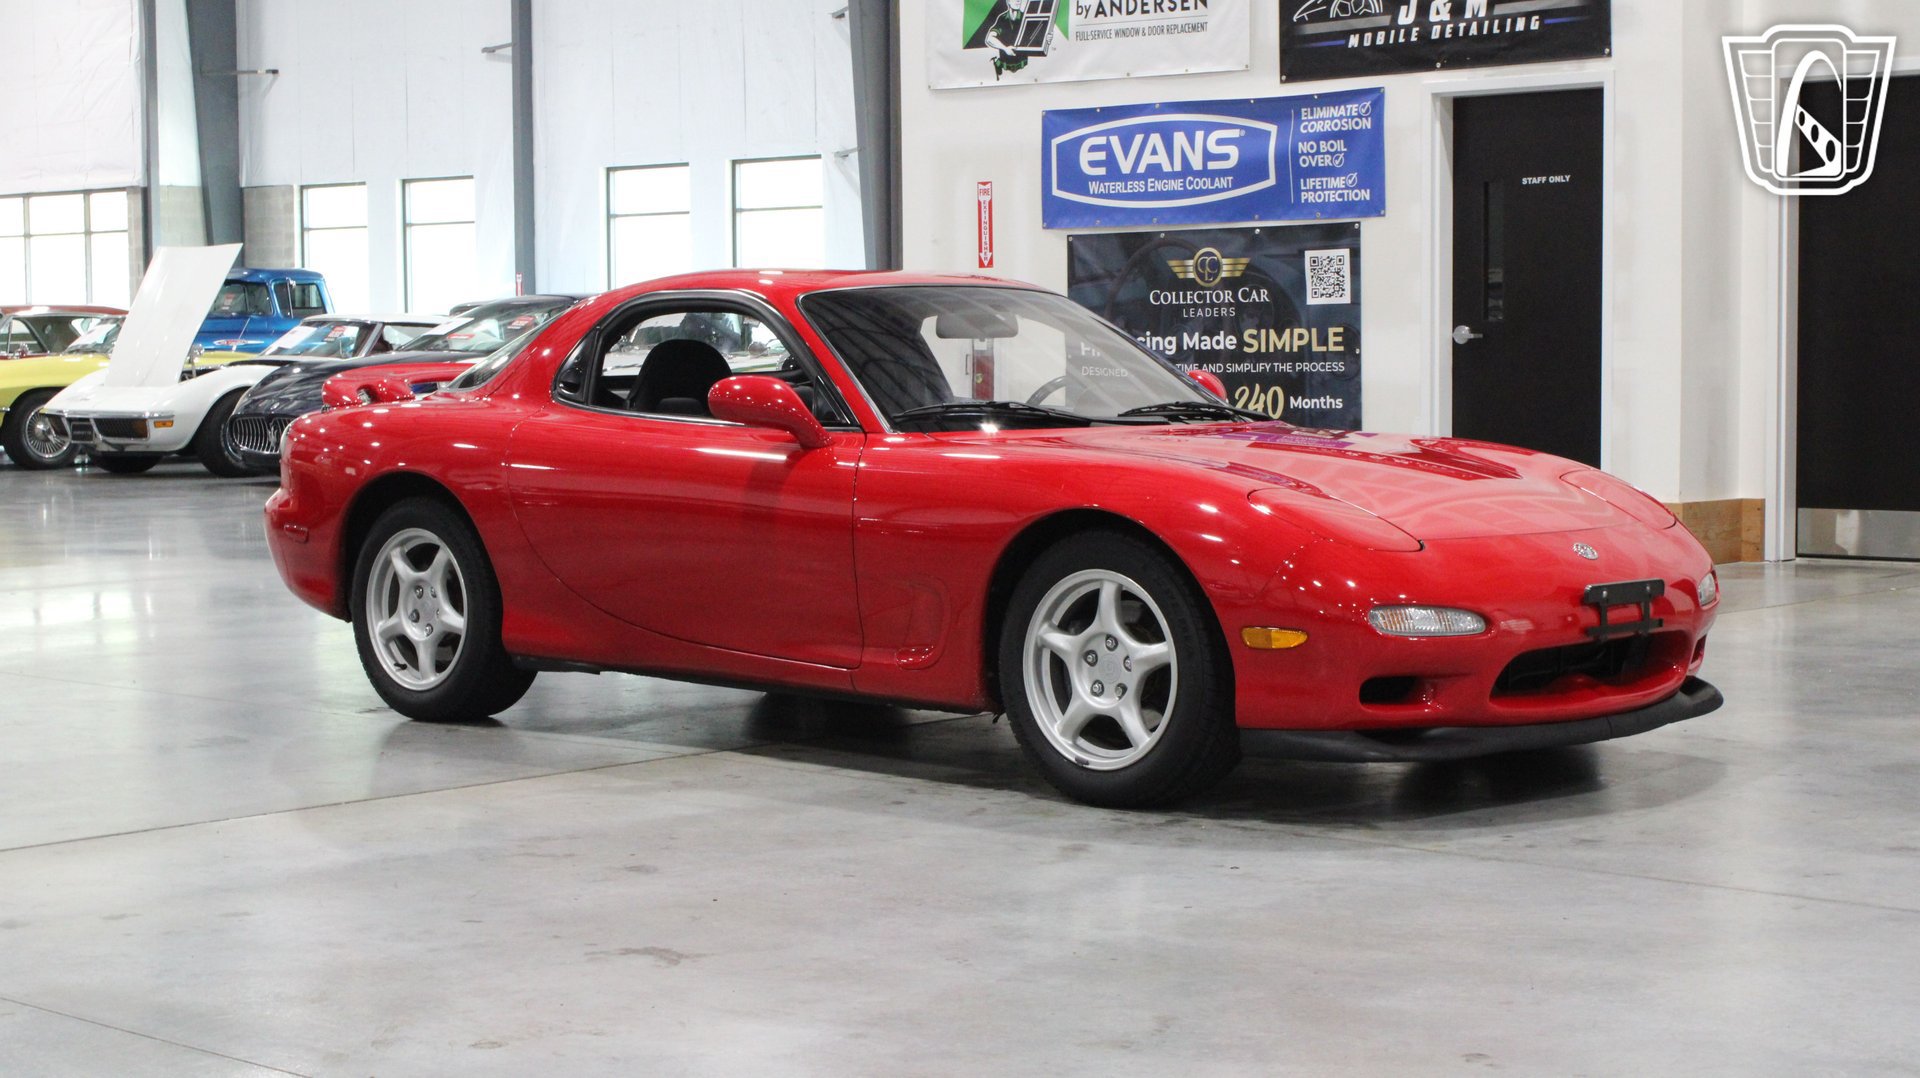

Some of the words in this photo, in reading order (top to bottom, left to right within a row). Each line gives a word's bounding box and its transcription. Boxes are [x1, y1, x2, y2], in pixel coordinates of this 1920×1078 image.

[1076, 0, 1091, 19] by
[1075, 29, 1112, 41] FULL-SERVICE
[1114, 27, 1140, 39] WINDOW
[1141, 27, 1146, 36] &
[1148, 25, 1165, 36] DOOR
[1166, 22, 1208, 35] REPLACEMENT
[1348, 27, 1420, 49] MOBILE
[1431, 15, 1540, 40] DETAILING
[1301, 104, 1359, 121] ELIMINATE
[1300, 117, 1372, 133] CORROSION
[1079, 128, 1241, 176] EVANS
[1298, 141, 1317, 154] NO
[1319, 139, 1347, 152] BOIL
[1299, 154, 1333, 168] OVER
[1147, 177, 1184, 192] ENGINE
[1185, 176, 1234, 190] COOLANT
[1300, 176, 1346, 190] LIFETIME
[1521, 176, 1547, 185] STAFF
[1549, 174, 1571, 183] ONLY
[979, 188, 990, 196] FIRE
[1301, 189, 1371, 203] PROTECTION
[1183, 307, 1236, 318] LEADERS
[1183, 330, 1238, 351] Made
[1243, 326, 1345, 353] SIMPLE
[1081, 366, 1129, 378] DESIGNED
[1201, 363, 1224, 374] AND
[1226, 362, 1271, 374] SIMPLIFY
[1273, 362, 1294, 373] THE
[1295, 361, 1345, 373] PROCESS
[1234, 383, 1285, 420] 240
[1289, 395, 1344, 410] Months
